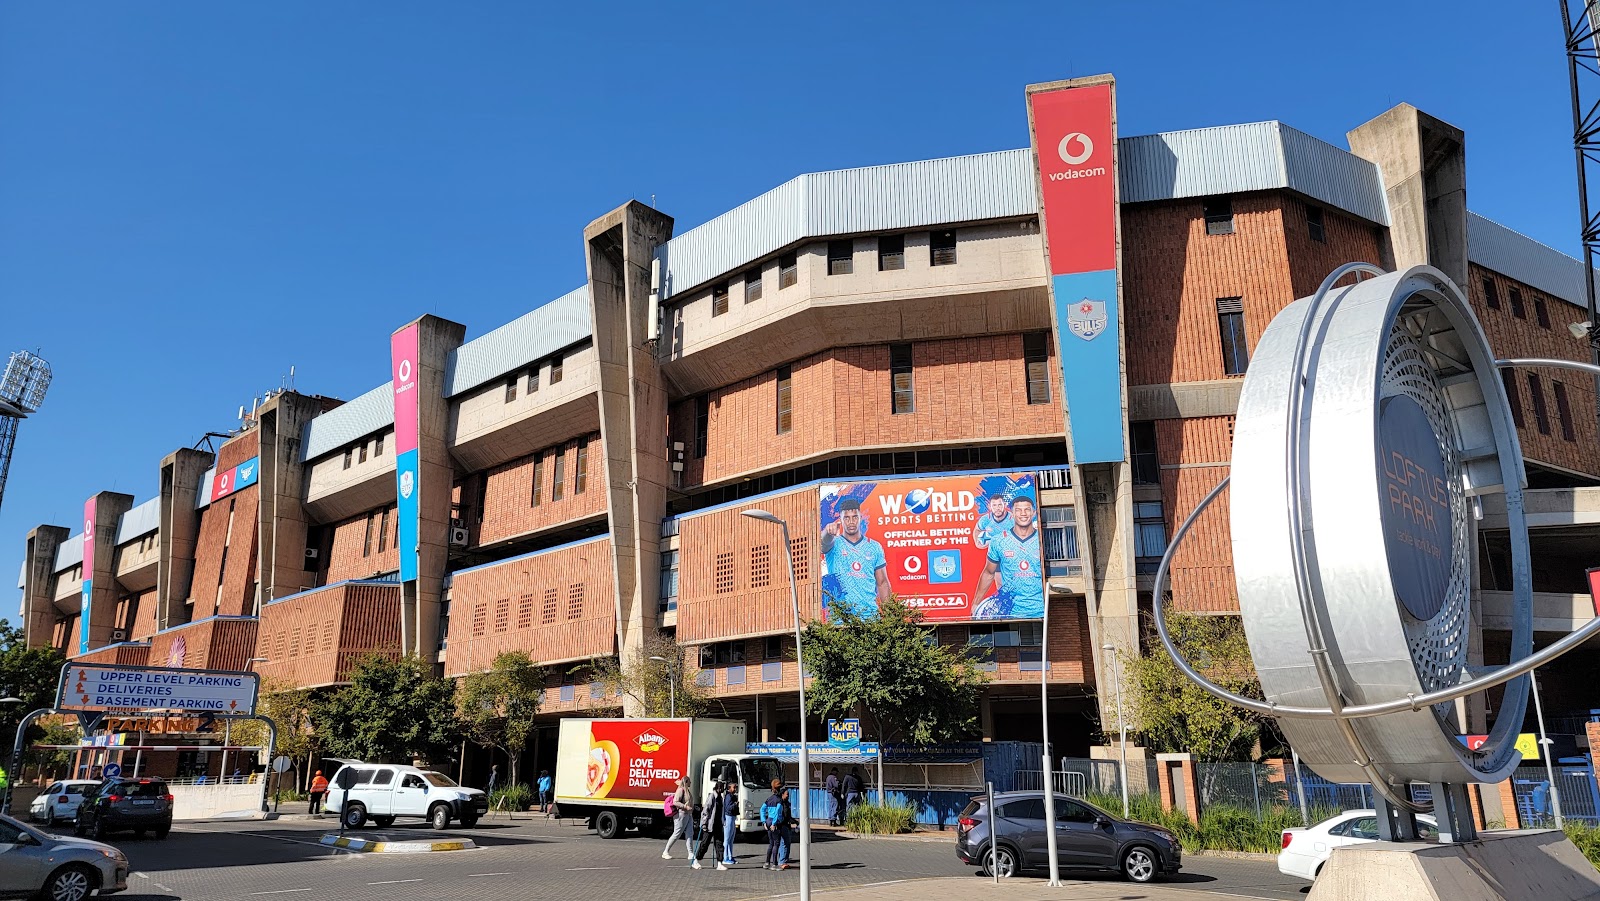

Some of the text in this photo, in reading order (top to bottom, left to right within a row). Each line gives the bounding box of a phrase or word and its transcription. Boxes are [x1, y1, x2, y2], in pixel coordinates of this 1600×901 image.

[1048, 167, 1106, 182] vodacom
[1073, 319, 1103, 331] BULLS
[1381, 445, 1447, 508] LOFTUS
[1388, 483, 1437, 534] PARK
[877, 512, 975, 526] SPORTS BETTING
[883, 528, 971, 539] OFFICIAL BETTING
[887, 537, 969, 548] PARTNER OF THE
[100, 672, 242, 687] UPPER LEVEL PARKING
[97, 684, 172, 695] DELIVERIES
[95, 696, 223, 709] BASEMENT PARKING
[107, 712, 215, 733] PARKING 2
[830, 722, 858, 732] TICKET
[731, 726, 745, 735] P77
[639, 733, 666, 746] Albany
[831, 732, 858, 741] SALES
[630, 759, 654, 768] LOVE
[629, 769, 681, 780] DELIVERED
[628, 778, 652, 788] DAILY
